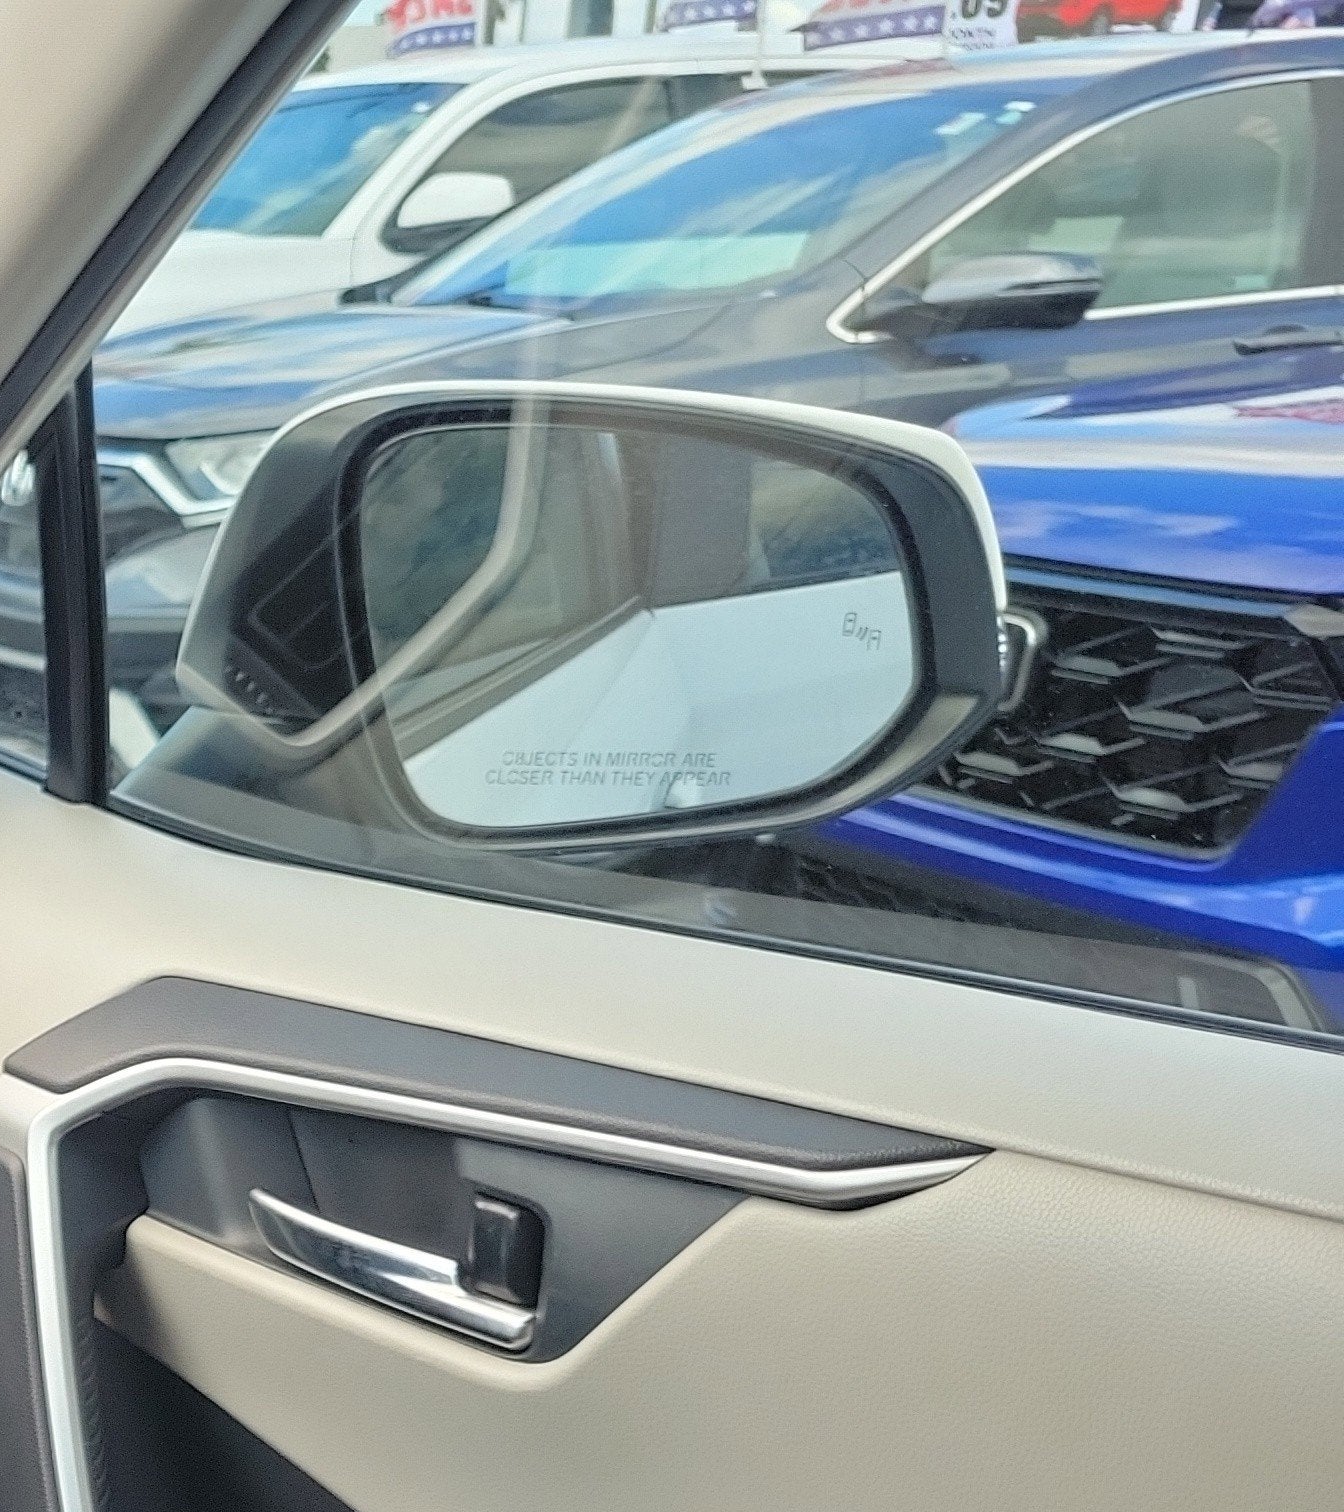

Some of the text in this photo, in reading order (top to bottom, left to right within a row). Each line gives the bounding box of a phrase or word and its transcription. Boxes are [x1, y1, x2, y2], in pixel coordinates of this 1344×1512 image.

[502, 751, 716, 768] OBJECTS IN MIRROR ARE
[484, 769, 731, 787] CLOSER THAN THEY APPEAR
